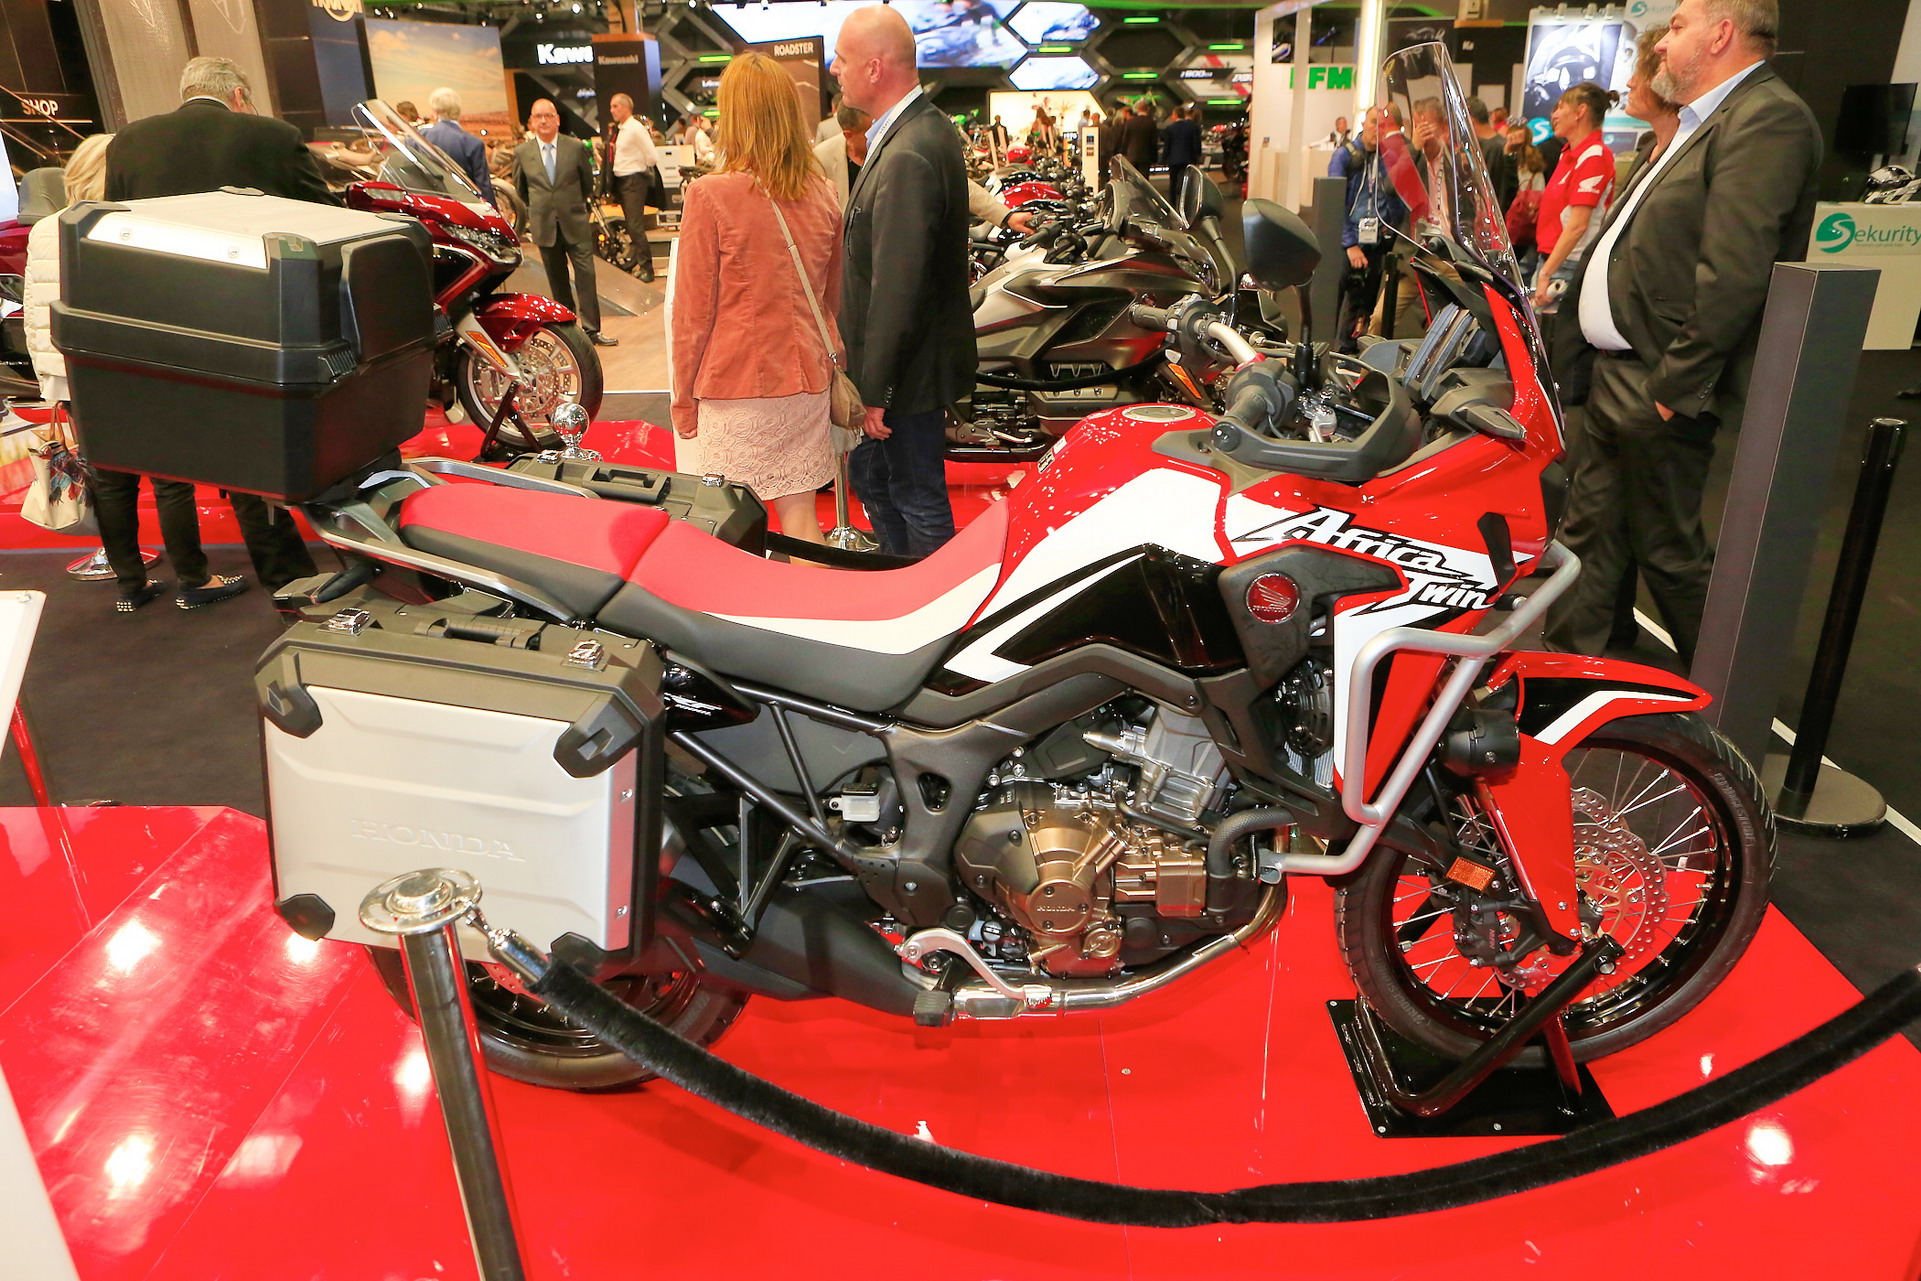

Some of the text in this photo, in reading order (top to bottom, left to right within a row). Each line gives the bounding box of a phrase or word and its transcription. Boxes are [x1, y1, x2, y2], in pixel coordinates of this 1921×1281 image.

[774, 42, 814, 57] ROADSTER
[21, 99, 59, 116] SHOP
[1236, 504, 1474, 578] Africa
[1352, 570, 1500, 617] Twin
[351, 819, 526, 862] HONDA
